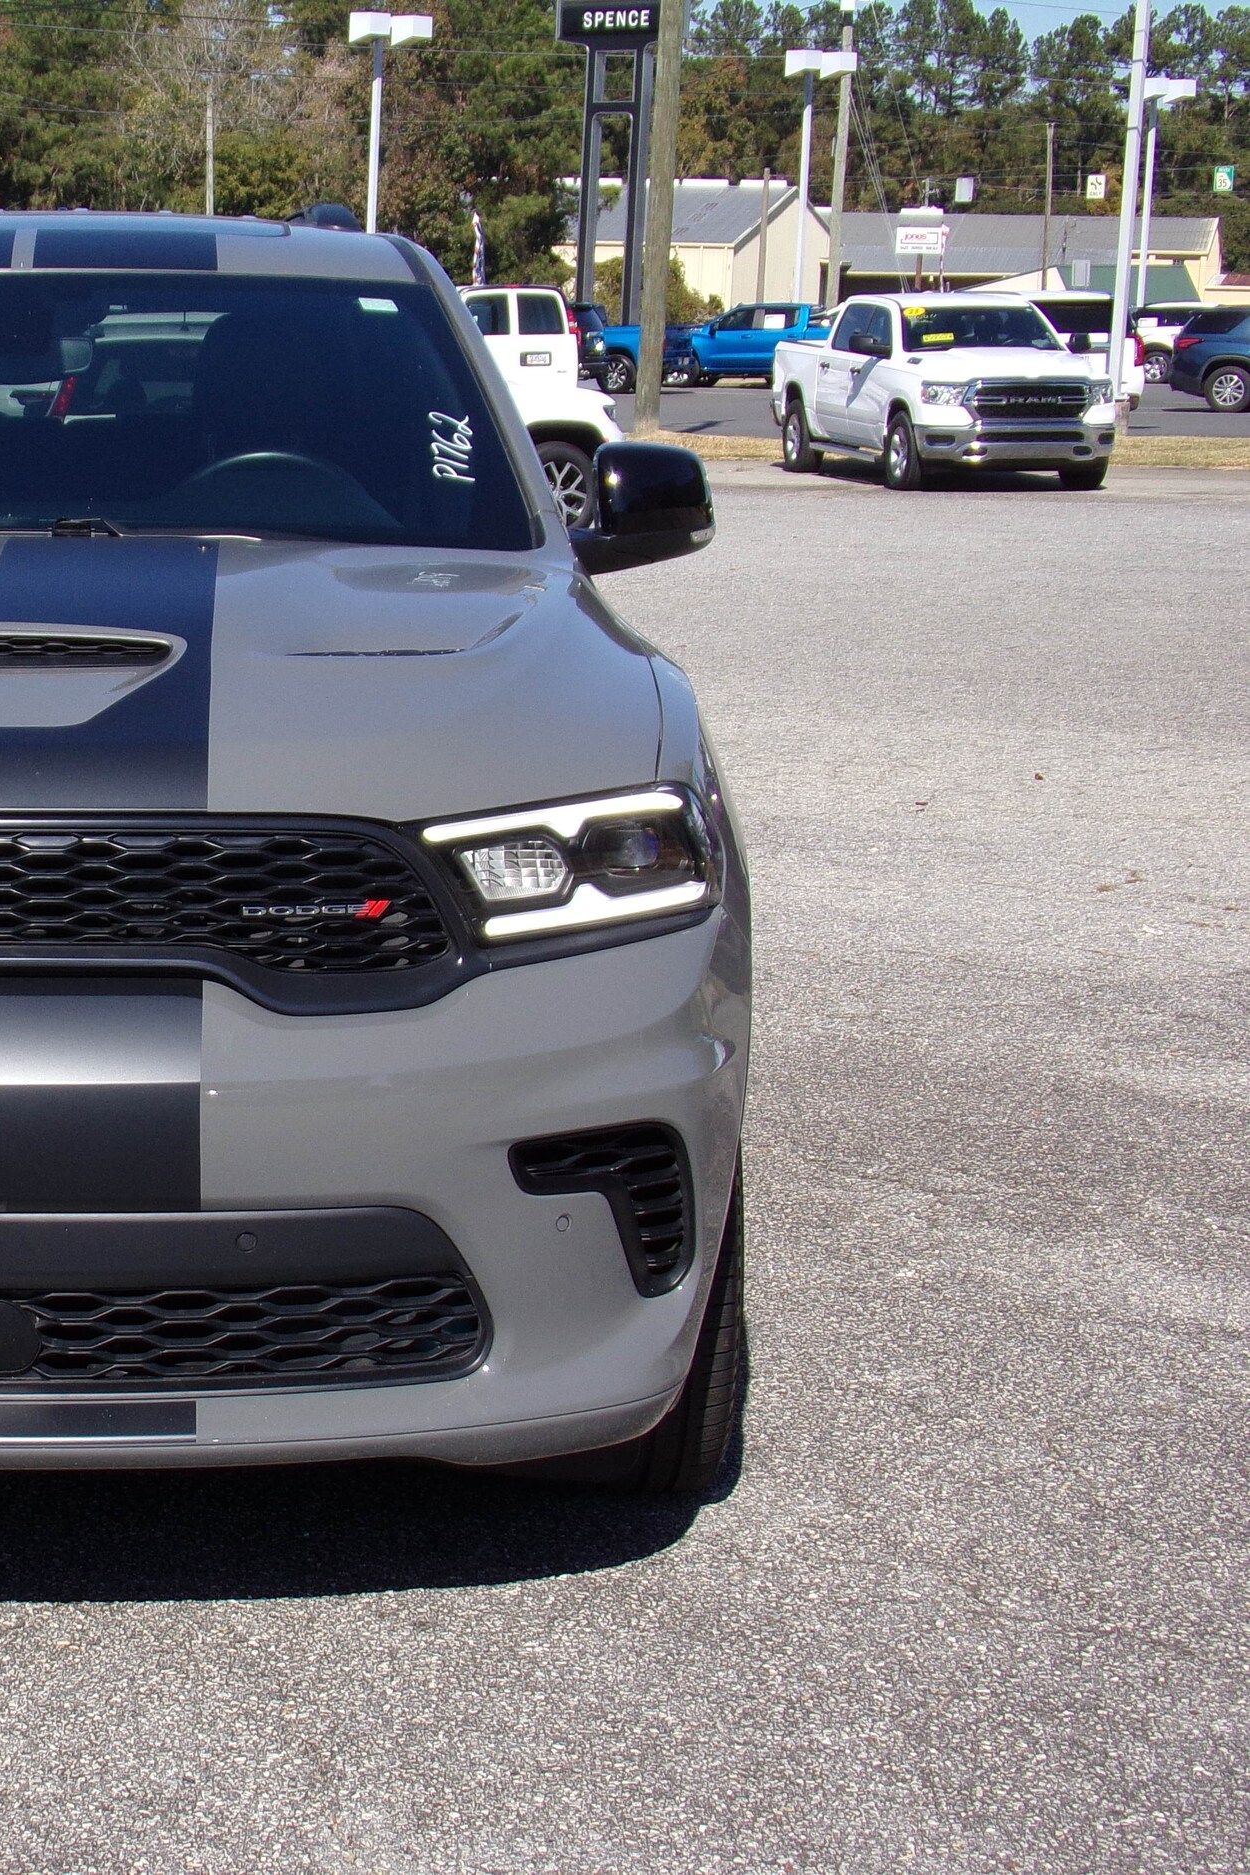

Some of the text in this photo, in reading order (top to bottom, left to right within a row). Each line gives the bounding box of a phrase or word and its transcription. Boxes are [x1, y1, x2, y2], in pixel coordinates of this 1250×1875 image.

[583, 9, 650, 27] SPENCE
[1217, 178, 1228, 188] 35
[242, 903, 370, 916] DODGE
